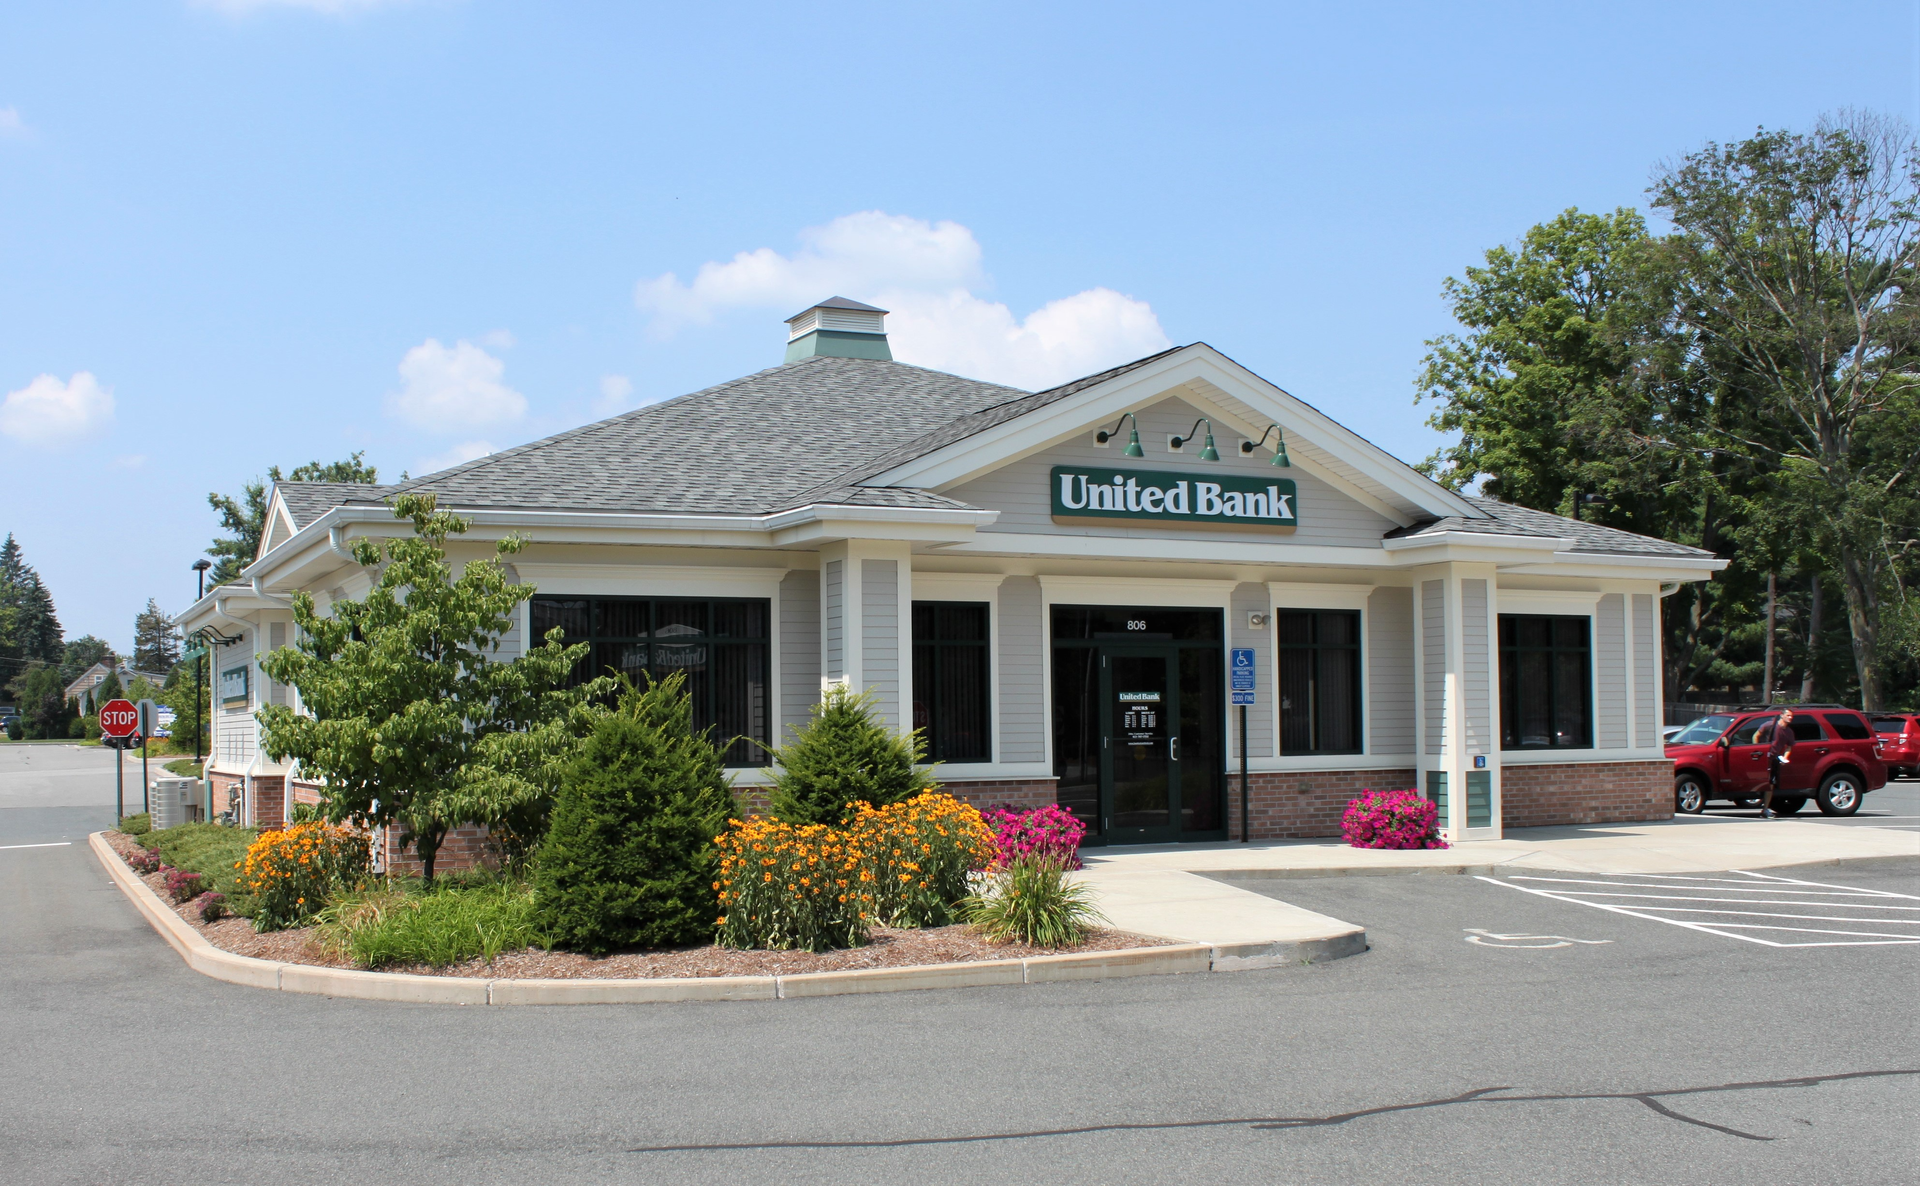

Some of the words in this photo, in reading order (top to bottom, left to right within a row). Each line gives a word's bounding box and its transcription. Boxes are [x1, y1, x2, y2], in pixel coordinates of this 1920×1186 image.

[1059, 474, 1190, 514] United
[1195, 481, 1294, 519] Bank
[1127, 620, 1146, 630] 806
[1232, 694, 1244, 702] $300
[1245, 694, 1254, 702] FINE
[103, 711, 136, 725] STOP
